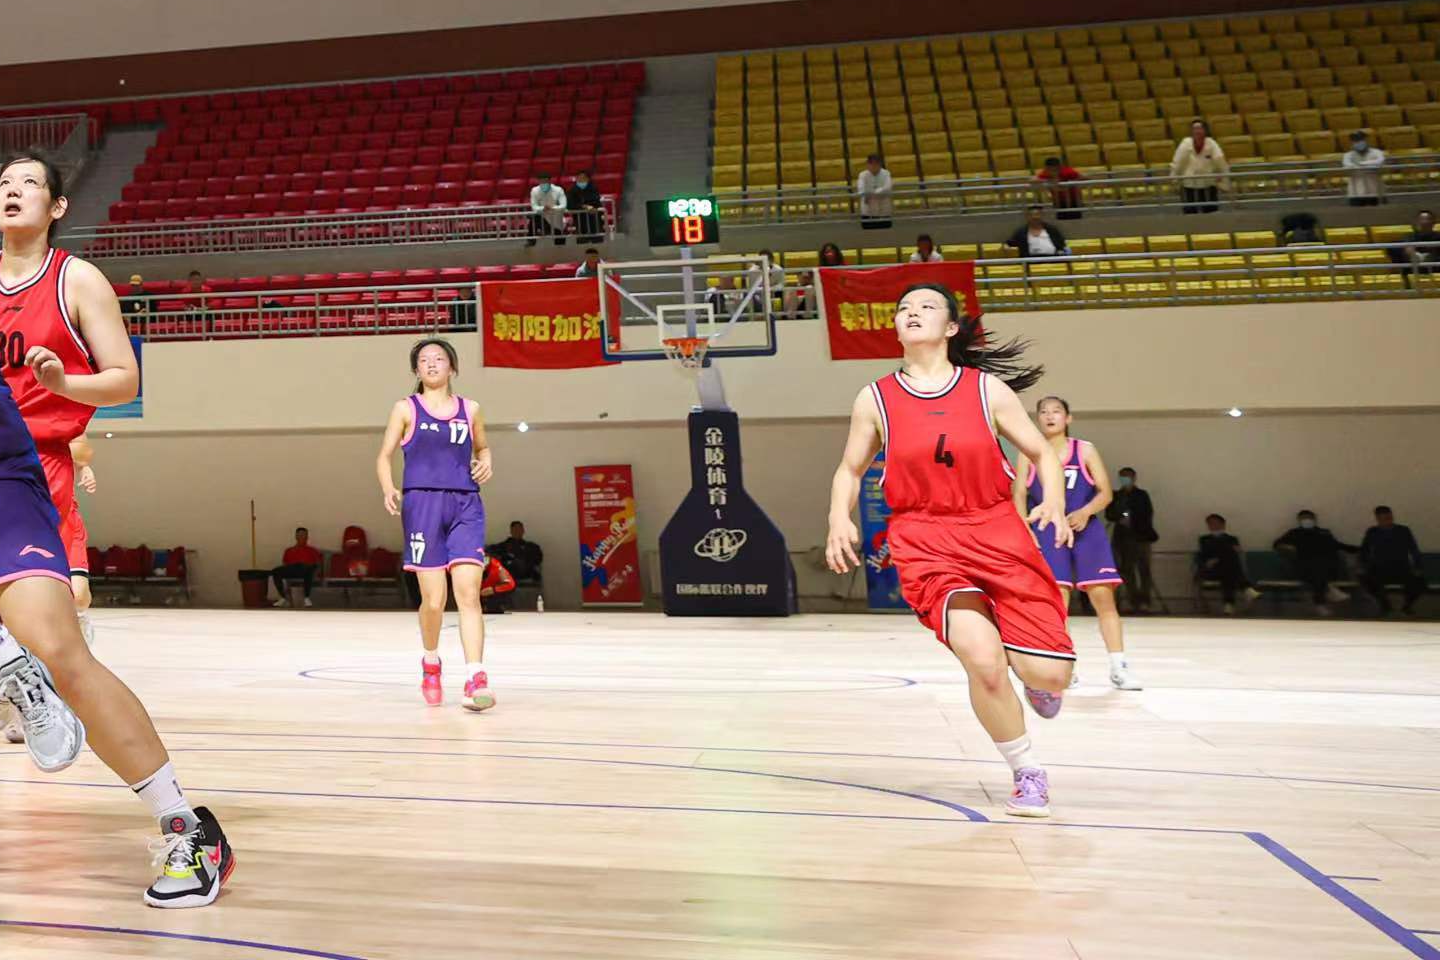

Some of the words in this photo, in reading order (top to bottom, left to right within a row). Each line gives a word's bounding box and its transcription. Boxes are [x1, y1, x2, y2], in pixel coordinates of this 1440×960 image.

[673, 216, 704, 243] 18
[449, 422, 469, 445] 17
[934, 434, 954, 468] 4
[704, 427, 728, 505] 金陵体育
[410, 542, 426, 565] 17
